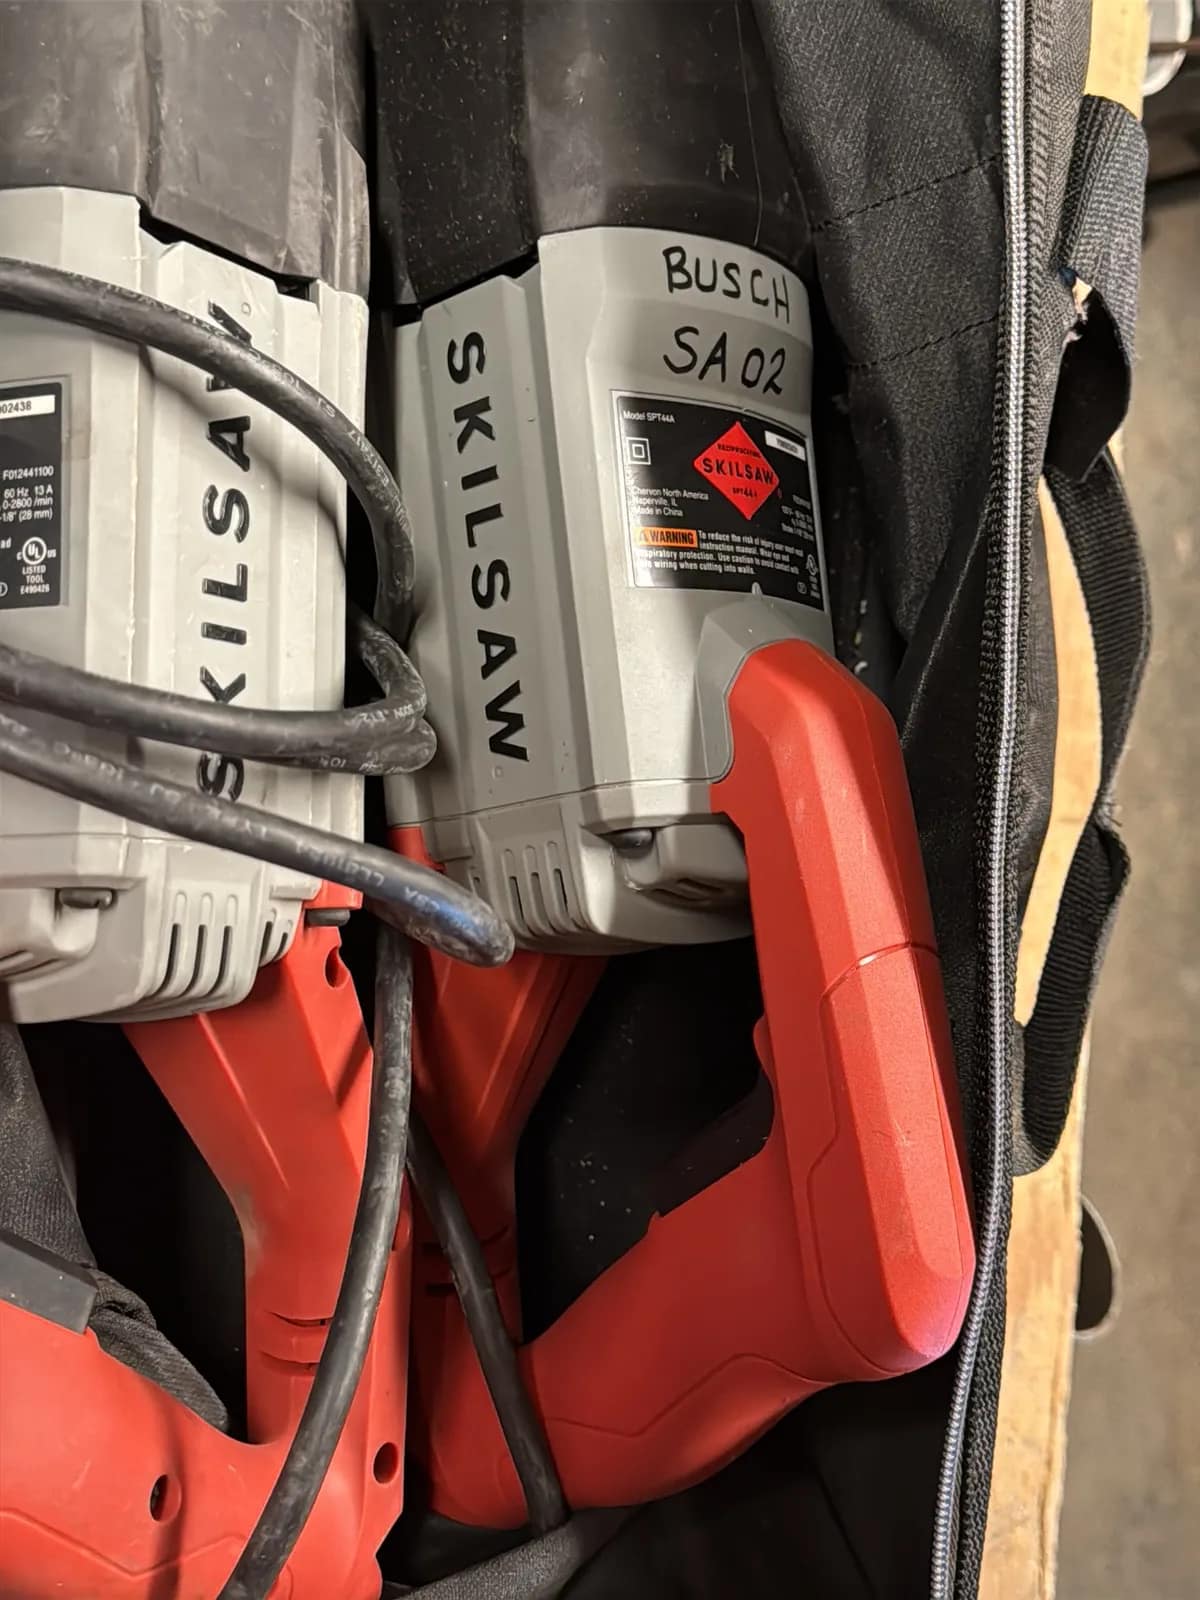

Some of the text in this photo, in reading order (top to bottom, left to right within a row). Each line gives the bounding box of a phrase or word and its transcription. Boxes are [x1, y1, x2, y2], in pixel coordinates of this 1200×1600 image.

[662, 245, 790, 324] BUSCH
[0, 400, 32, 414] 02438
[623, 410, 646, 421] Model
[3, 465, 55, 481] F012441100
[702, 458, 774, 485] SKILSAW
[4, 483, 54, 499] 60 Hz 13 A
[662, 488, 682, 499] North
[683, 490, 709, 501] America
[33, 507, 53, 520] mm)
[655, 507, 663, 516] in
[663, 507, 684, 517] China
[649, 529, 695, 546] WARNING
[447, 331, 530, 762] SKILSAW
[637, 549, 678, 559] spiratory
[22, 564, 47, 575] LISTED
[26, 574, 45, 585] TOOL
